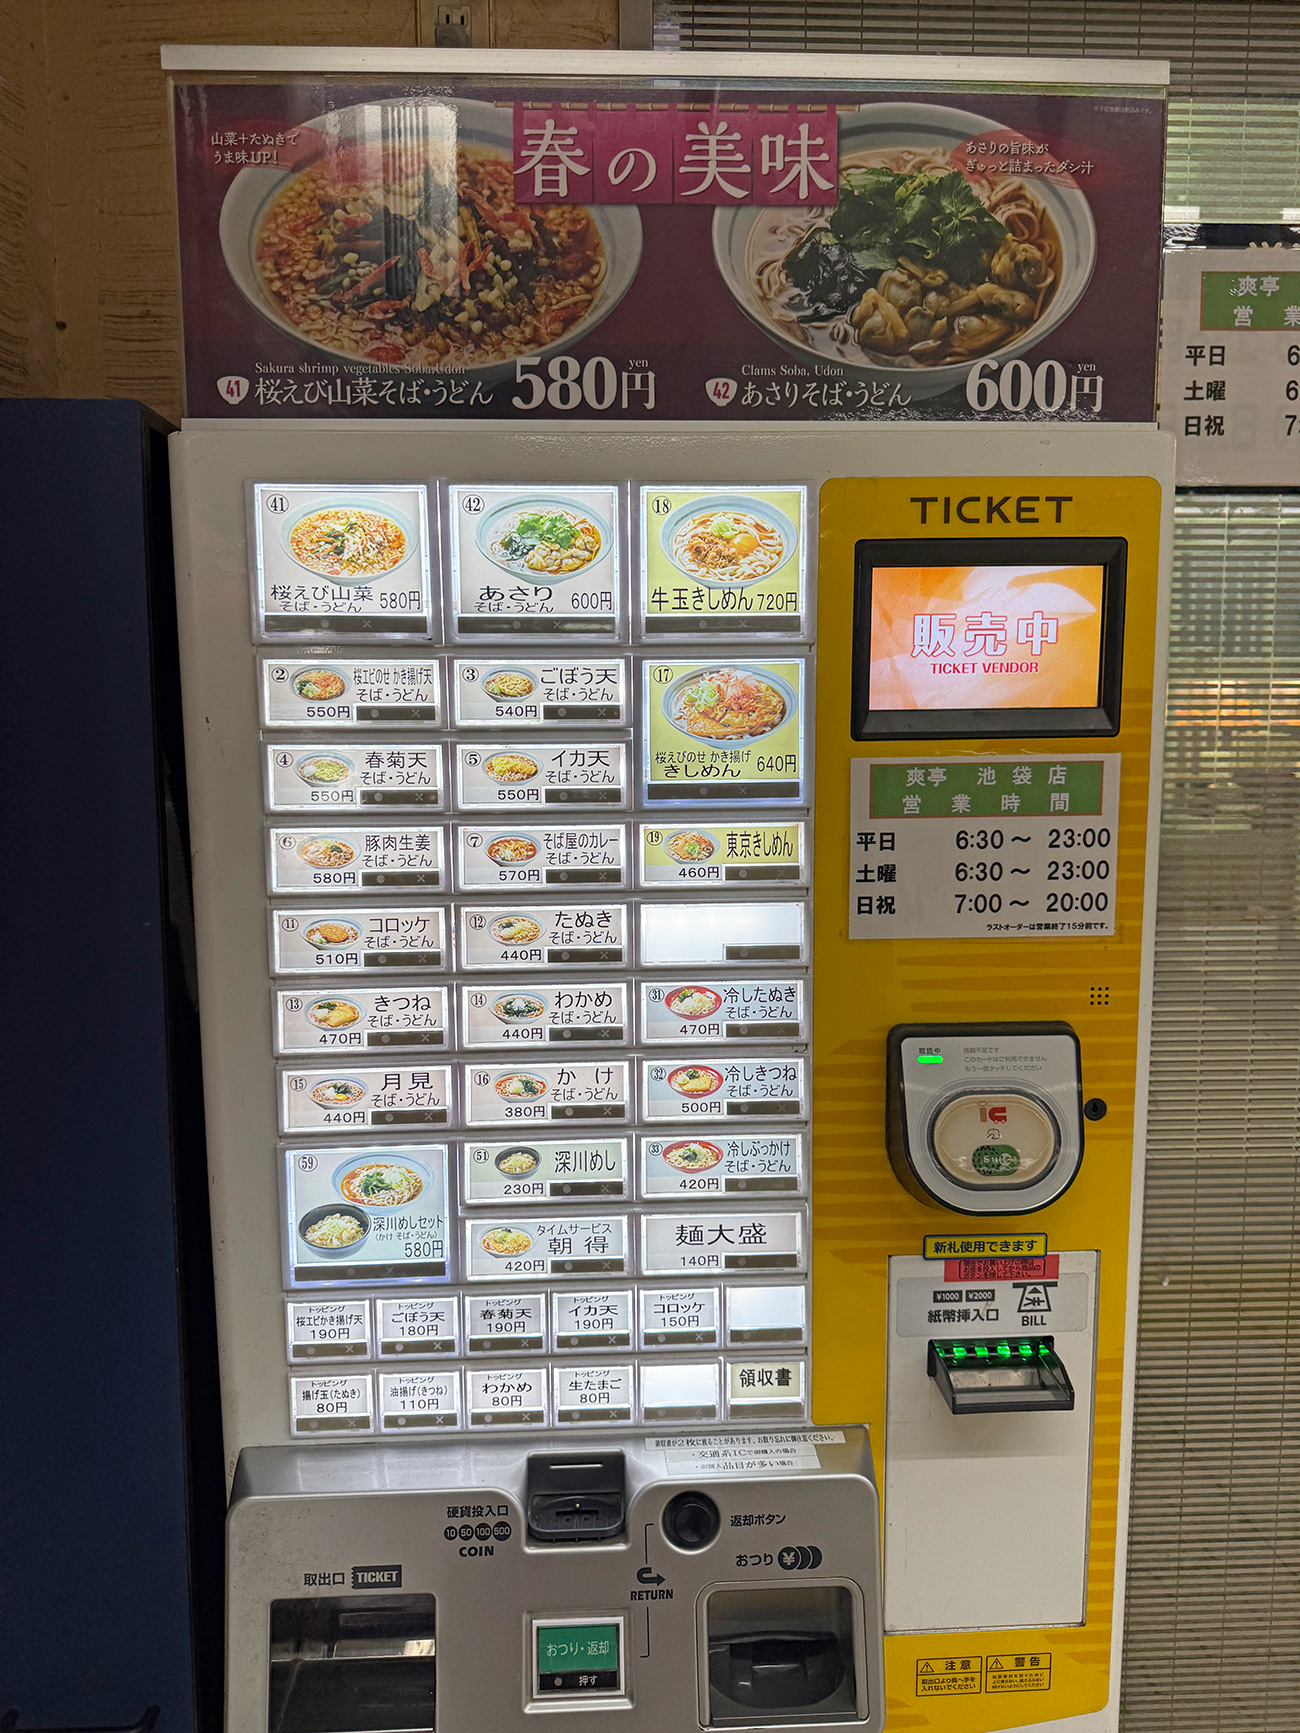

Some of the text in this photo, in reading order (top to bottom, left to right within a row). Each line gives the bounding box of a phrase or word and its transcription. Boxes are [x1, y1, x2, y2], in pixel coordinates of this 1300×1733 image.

[966, 141, 1049, 155] あさりの旨味が
[513, 117, 837, 198] 春の美味
[966, 158, 1094, 174] ぎゅっと詰まったダシ汁
[1185, 345, 1225, 366] 平日
[255, 363, 294, 375] Sakura
[299, 363, 339, 378] shrimp
[343, 363, 400, 377] vegetables
[628, 358, 649, 370] yen
[1077, 363, 1096, 374] yen
[741, 364, 844, 378] Clams Soba, Udon
[225, 382, 241, 397] 41
[512, 356, 656, 410] 580円
[965, 359, 1104, 413] 600円
[254, 378, 494, 406] 桜えび山菜そば・うどん
[712, 381, 730, 399] 42
[740, 381, 912, 408] あさりそば・うどん
[1184, 380, 1225, 401] 土曜
[1184, 415, 1224, 436] 日祝
[910, 496, 1073, 524] TICKET
[270, 584, 420, 610] 桜えび山菜 580円
[479, 586, 612, 610] あさり 600円
[651, 587, 797, 611] 牛玉きしめん 720円
[279, 601, 362, 612] そば・うどん
[473, 602, 553, 613] そば・うどん
[911, 611, 1058, 657] 販売中
[930, 662, 1039, 674] TICKET VENDOR
[541, 668, 618, 684] ごぼう天
[356, 688, 428, 702] そば・うどん
[543, 688, 614, 701] そば・うどん
[307, 706, 350, 718] 550円
[495, 706, 537, 717] 540円
[365, 751, 428, 768] 春菊天
[552, 750, 610, 767] イカ天
[664, 755, 796, 778] きしめん 640円
[360, 772, 431, 785] そば・うどん
[545, 771, 615, 783] そば・うどん
[906, 767, 947, 787] 爽亭
[311, 790, 353, 802] 550円
[498, 789, 539, 801] 550円
[365, 834, 430, 852] 豚肉生姜
[543, 833, 618, 849] そば屋のカレー
[726, 831, 793, 858] 東京きしめん
[856, 828, 1110, 851] 平日 6:30 23:00
[362, 855, 432, 867] そば・うどん
[546, 852, 615, 865] そば・うどん
[313, 872, 355, 884] 580円
[499, 870, 540, 881] 570円
[679, 867, 719, 878] 460円
[856, 860, 1110, 883] 土曜 6:30 23:00
[856, 892, 1110, 915] 日祝 7:00 20:00
[369, 916, 430, 933] コロッケ
[555, 911, 612, 928] たぬき
[364, 935, 434, 948] そば・うどん
[549, 931, 617, 944] そば・うどん
[316, 953, 358, 965] 510円
[501, 949, 541, 961] 440円
[555, 991, 612, 1009] わかめ
[723, 987, 796, 1003] 冷したぬき
[375, 995, 431, 1012] きつね
[549, 1011, 616, 1024] そば・うどん
[725, 1006, 792, 1019] そば・うどん
[368, 1014, 436, 1027] そば・うどん
[502, 1028, 543, 1039] 440円
[680, 1024, 719, 1035] 470円
[319, 1033, 361, 1044] 470円
[725, 1065, 797, 1082] 冷しきつね
[551, 1088, 618, 1101] そば・うどん
[727, 1085, 793, 1097] そば・うどん
[371, 1094, 439, 1107] そば・うどん
[505, 1106, 545, 1117] 380円
[681, 1102, 721, 1113] 500円
[324, 1112, 365, 1123] 440円
[727, 1140, 790, 1157] 冷しぶっかけ
[555, 1150, 616, 1173] 深川めし
[725, 1160, 791, 1173] そば・うどん
[504, 1183, 544, 1195] 230円
[679, 1178, 719, 1190] 420円
[373, 1215, 443, 1231] 深川めしセット
[537, 1223, 612, 1236] タイムサービス
[675, 1223, 767, 1246] 麺大盛
[404, 1240, 443, 1258] 580円
[933, 1240, 1037, 1253] 新札使用できます
[505, 1260, 545, 1272] 420円
[681, 1256, 718, 1266] 140円
[480, 1308, 532, 1320] 春菊天
[568, 1305, 618, 1317] イカ天
[654, 1302, 705, 1314] コロッケ
[296, 1314, 363, 1327] 桜エビかき揚げ天
[392, 1311, 445, 1323] ごぼう天
[661, 1316, 699, 1327] 150円
[927, 1309, 999, 1324] 紙幣挿入口
[1021, 1316, 1046, 1326] BILL
[487, 1321, 525, 1333] 190円
[575, 1318, 613, 1329] 190円
[311, 1328, 349, 1339] 190円
[400, 1325, 438, 1336] 180円
[739, 1367, 792, 1388] 領収書
[482, 1382, 532, 1394] わかめ
[568, 1379, 622, 1391] 生たまご
[400, 1398, 439, 1410] 110円
[492, 1395, 522, 1406] 80円
[580, 1392, 610, 1403] 80円
[317, 1402, 348, 1413] 80円
[447, 1505, 509, 1519] 硬貨投入口
[730, 1514, 786, 1527] 返却ボタン
[459, 1546, 494, 1557] COIN
[736, 1553, 773, 1567] おつり
[304, 1571, 398, 1586] 取出口 TICKET
[630, 1589, 673, 1601] RETURN
[547, 1640, 610, 1657] おつり・返却
[579, 1675, 598, 1686] 押す
